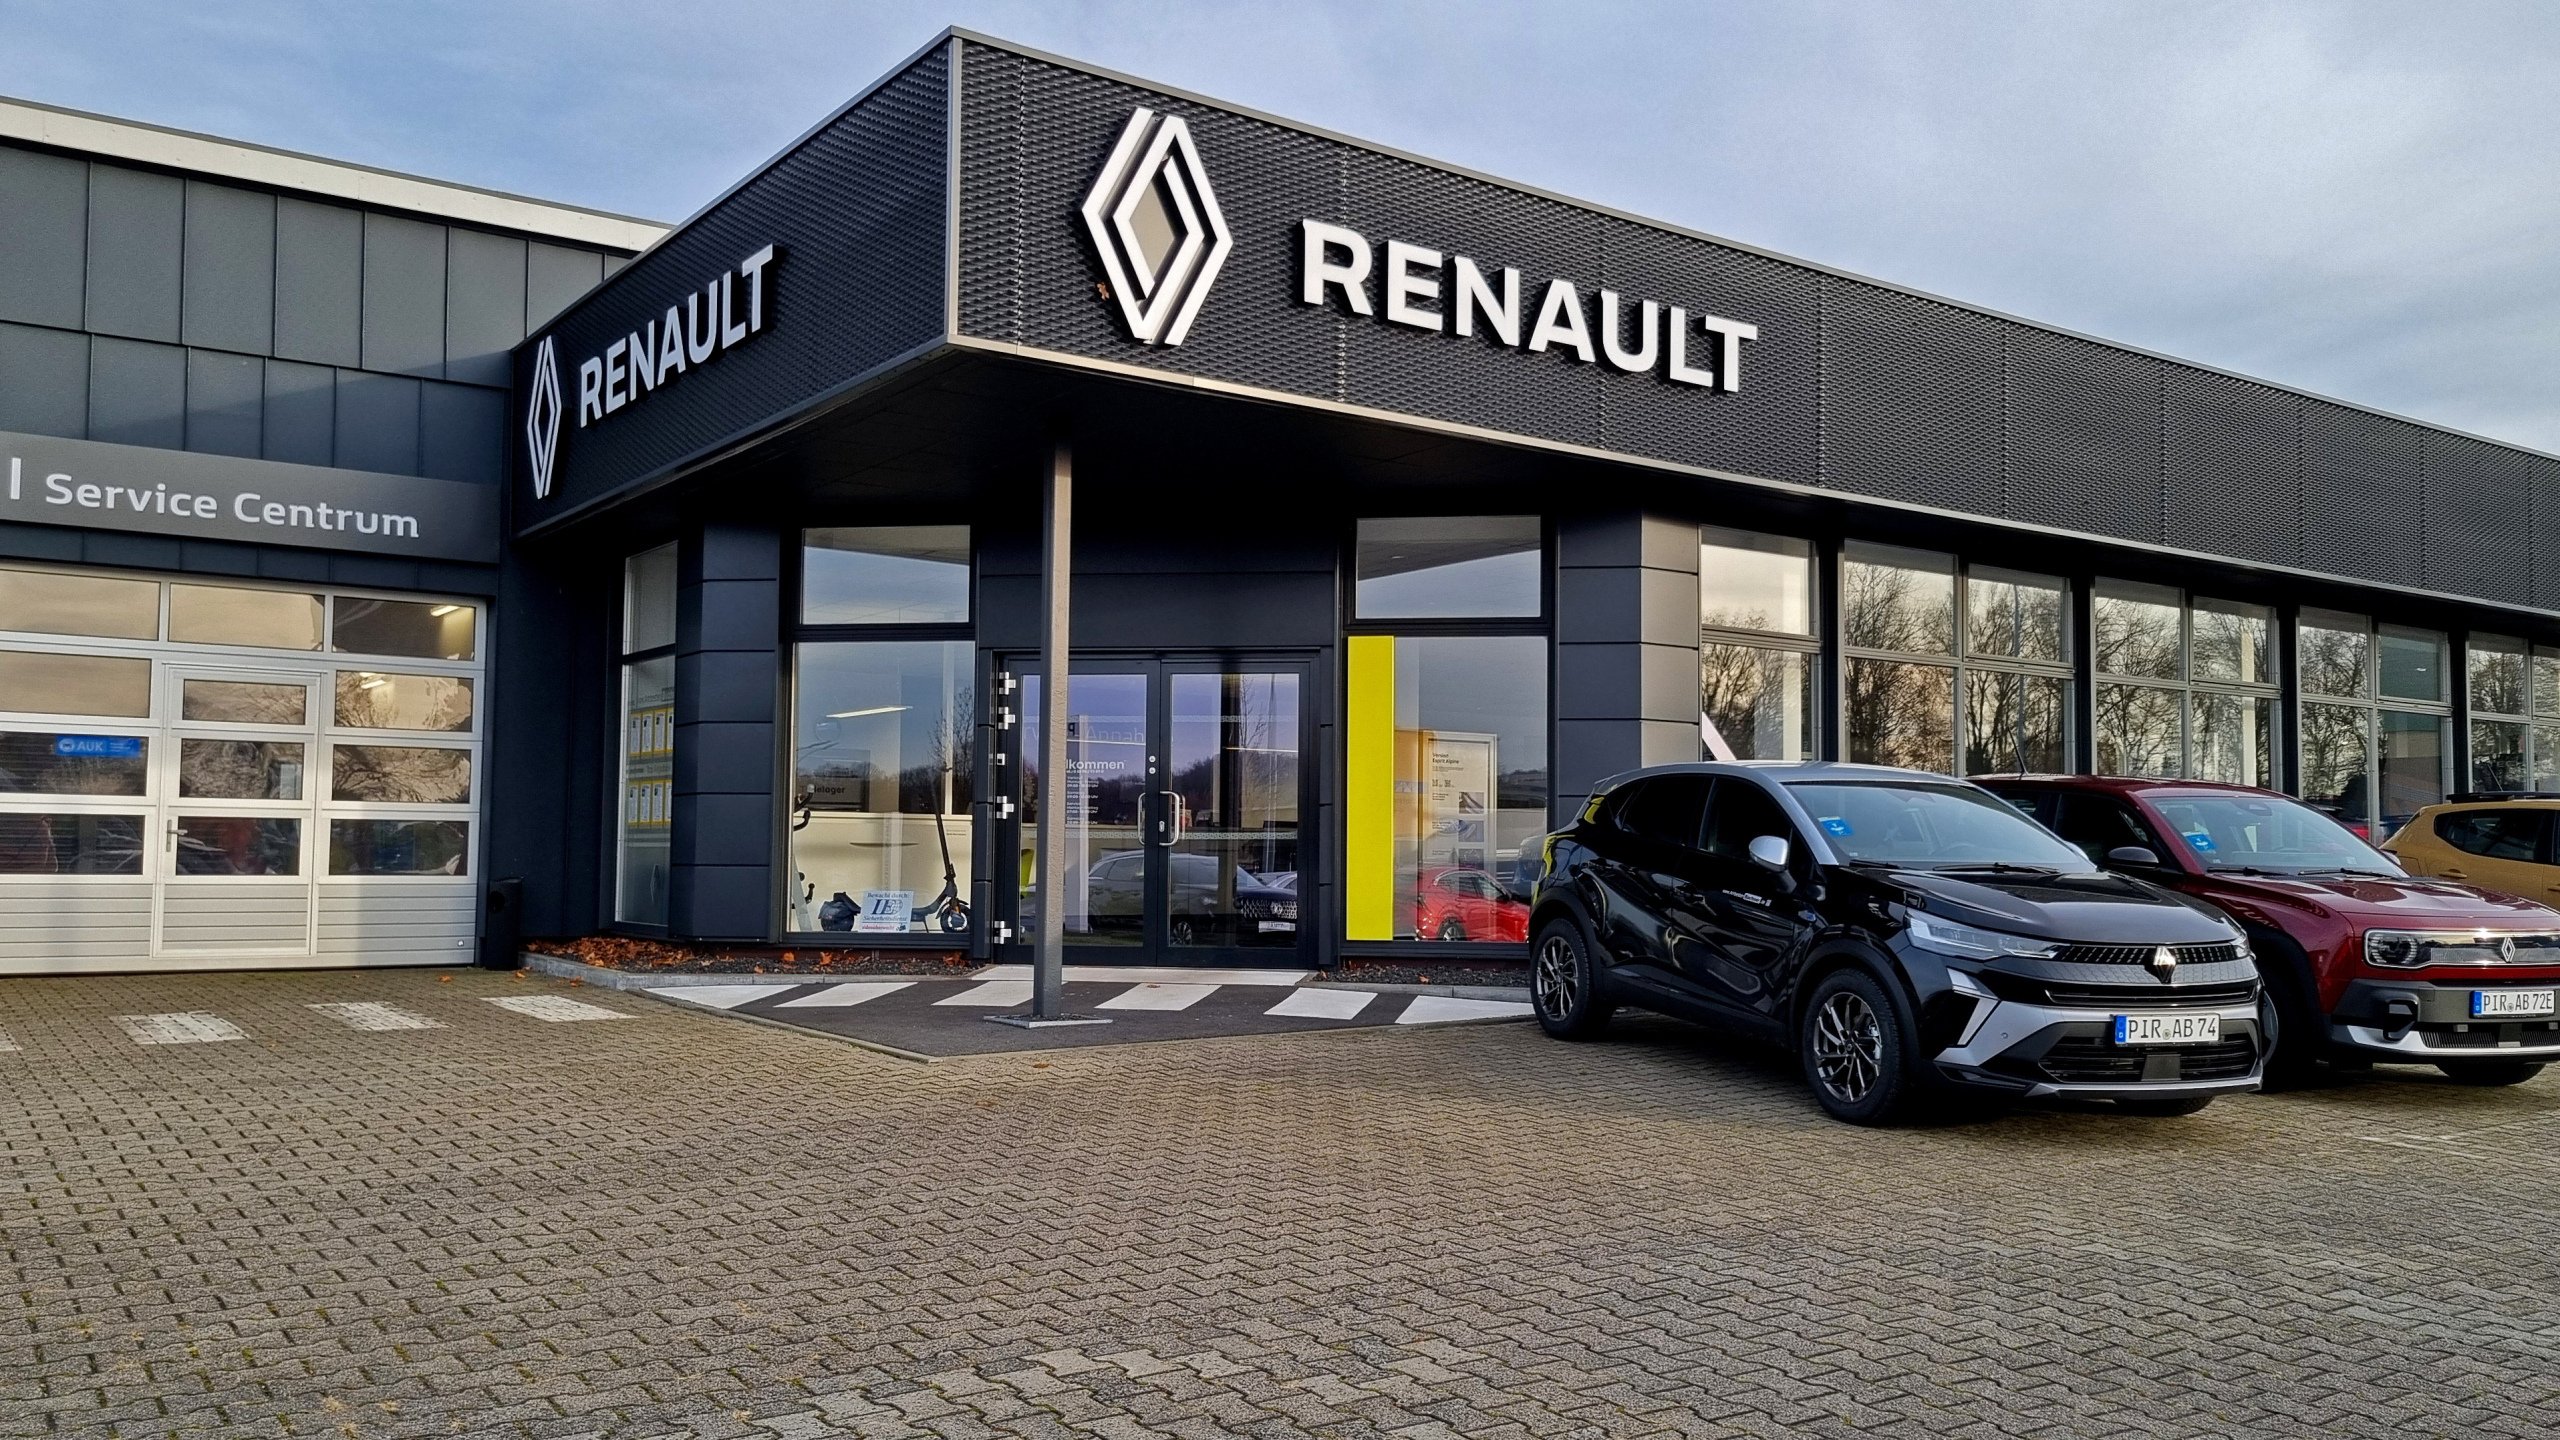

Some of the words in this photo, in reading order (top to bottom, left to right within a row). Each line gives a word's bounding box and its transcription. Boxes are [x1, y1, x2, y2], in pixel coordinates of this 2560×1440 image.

[1302, 218, 1758, 392] RENAULT
[580, 243, 773, 428] RENAULT
[45, 473, 218, 519] Service
[234, 493, 420, 538] Centrum
[1066, 759, 1125, 769] lkommen
[2483, 994, 2507, 1011] PIR
[2515, 994, 2530, 1010] AB
[2532, 993, 2553, 1010] 72E
[2128, 1019, 2161, 1039] PIR
[2172, 1018, 2194, 1038] AB
[2198, 1018, 2216, 1036] 74
